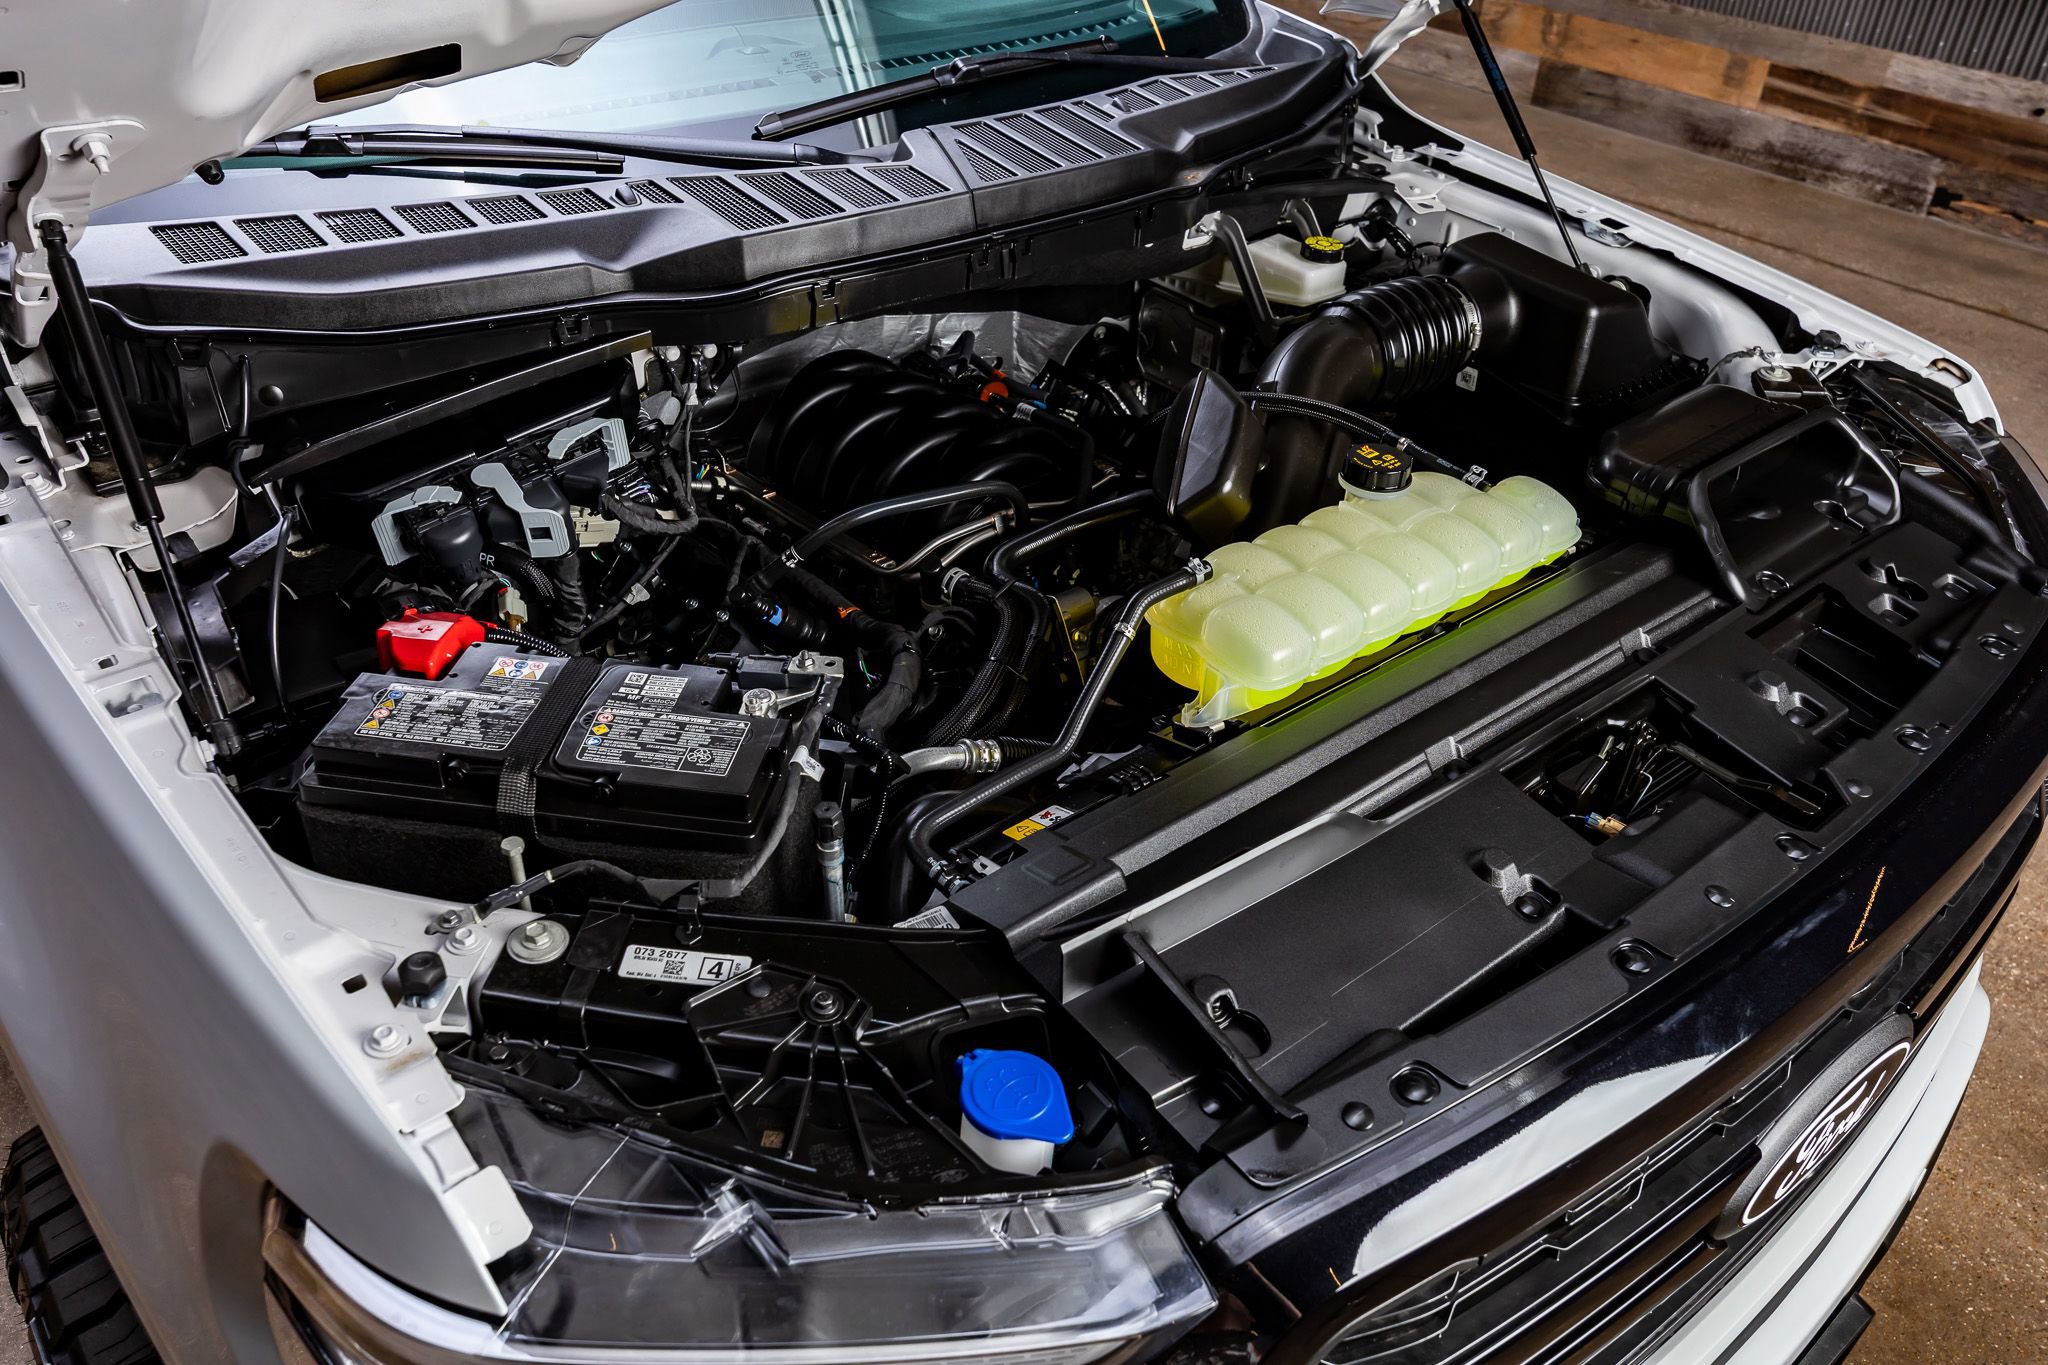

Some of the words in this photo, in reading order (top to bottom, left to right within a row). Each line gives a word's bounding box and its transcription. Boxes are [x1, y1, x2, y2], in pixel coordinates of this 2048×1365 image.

[643, 697, 675, 705] FoMoCo
[633, 946, 655, 956] 073
[658, 950, 688, 960] 2677
[706, 961, 723, 978] 4
